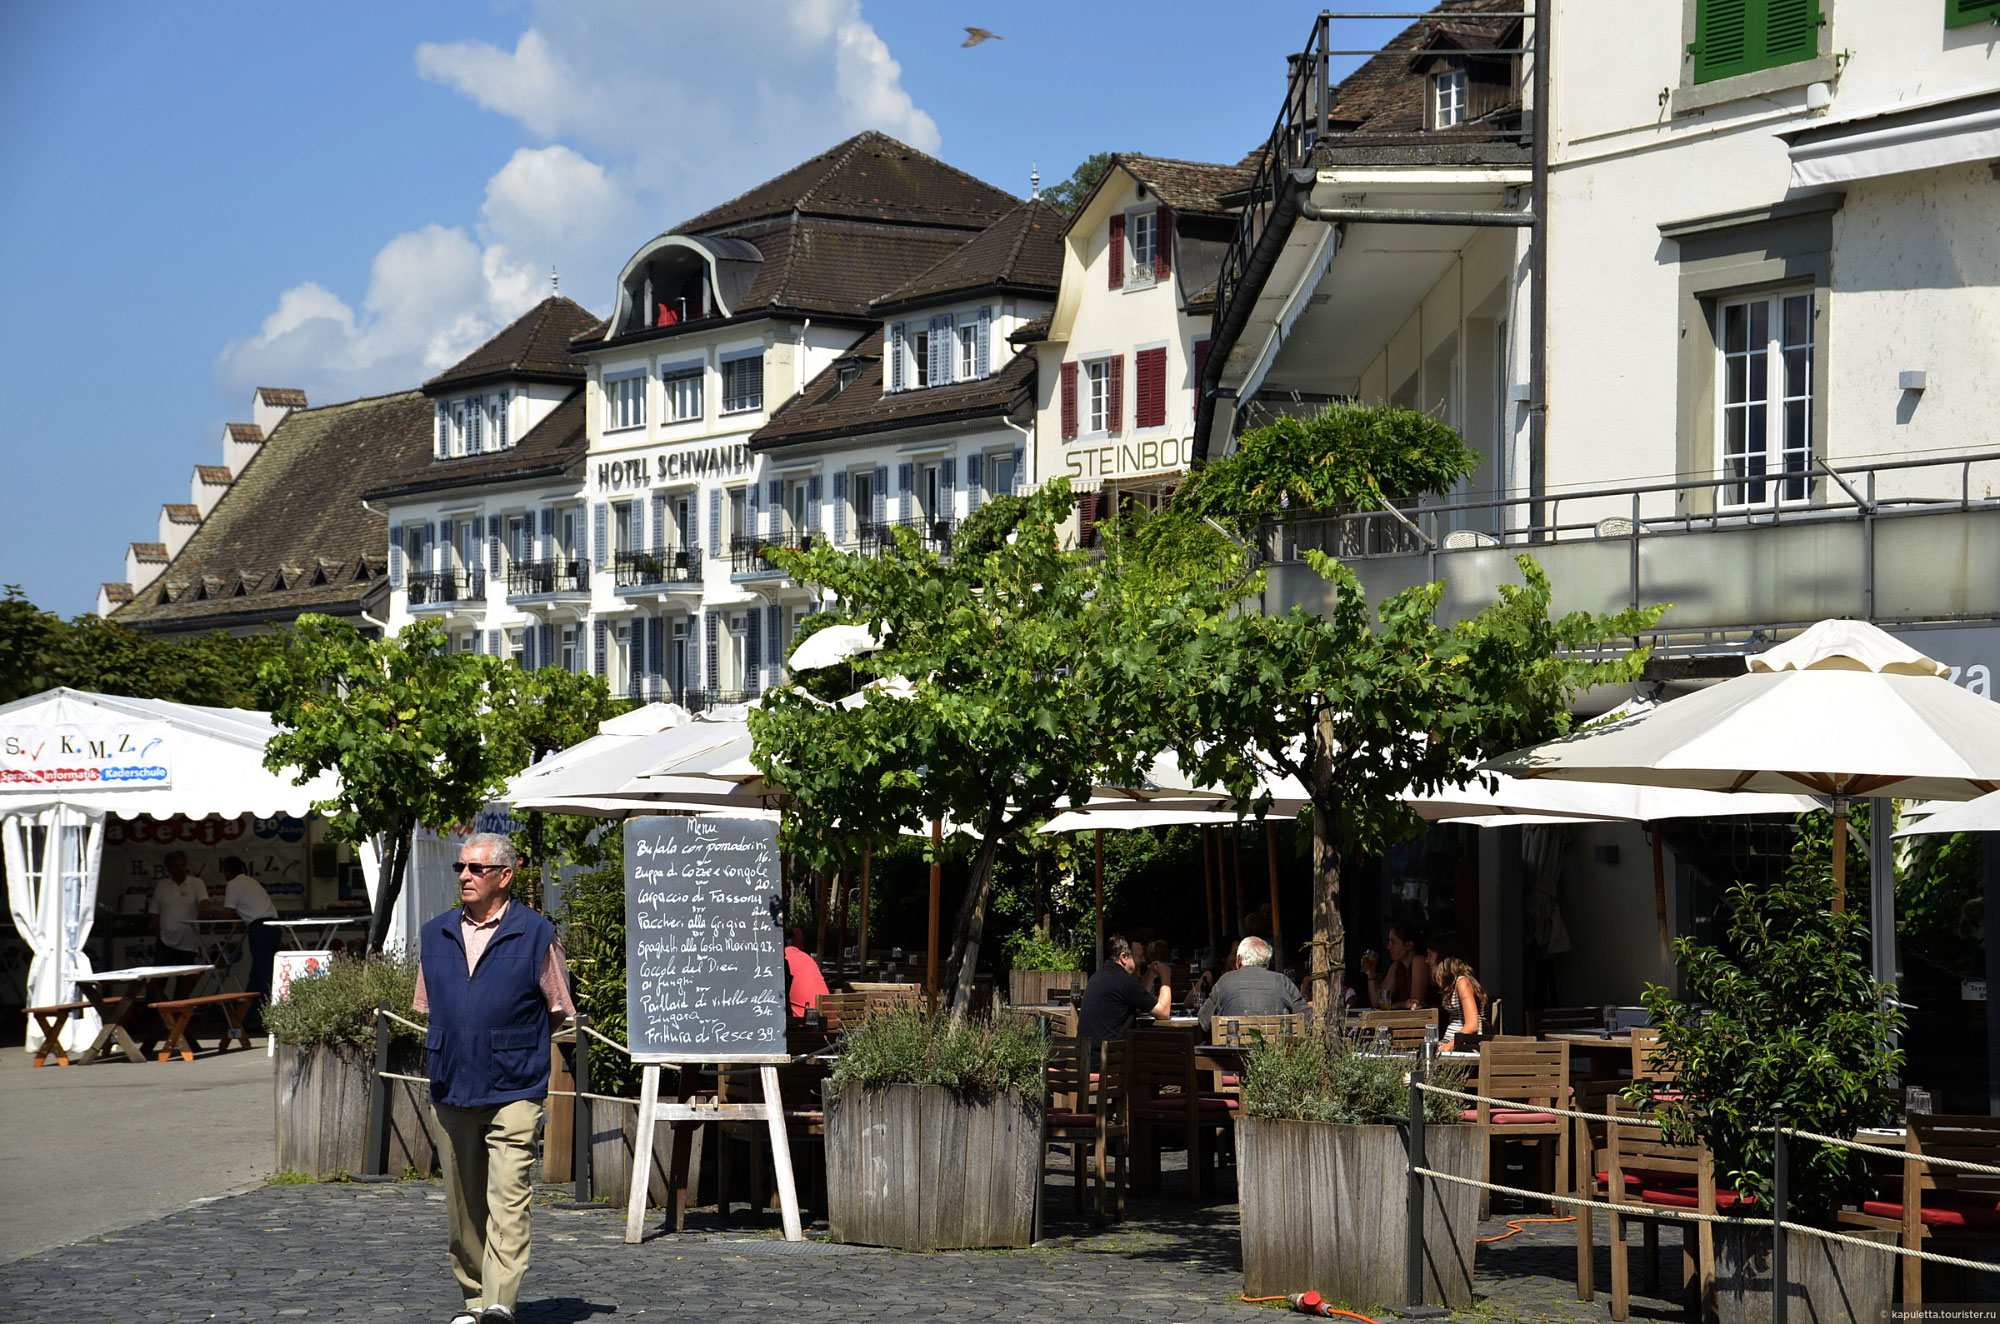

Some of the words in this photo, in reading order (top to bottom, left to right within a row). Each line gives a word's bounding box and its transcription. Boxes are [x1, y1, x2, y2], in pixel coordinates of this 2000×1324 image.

[598, 457, 650, 488] HOTEL
[657, 443, 755, 479] SCHWANEN
[105, 766, 166, 780] Kaderschule
[687, 817, 719, 835] Menu
[636, 835, 678, 861] Bufala
[681, 843, 702, 854] con
[703, 836, 768, 863] pomodorini
[634, 866, 664, 886] Zuppa
[667, 862, 678, 877] di
[713, 867, 720, 877] e
[637, 889, 689, 911] Carpaccio
[691, 886, 705, 903] di
[637, 911, 684, 930] Paccheri
[688, 914, 706, 929] alla
[711, 916, 747, 938] Grigia
[637, 934, 678, 960] Spaghetti
[700, 935, 723, 952] Costa
[725, 938, 759, 953] Marina
[640, 955, 676, 977] Coccole
[682, 955, 704, 974] del
[708, 957, 738, 974] Dieci
[656, 975, 693, 997] funghi
[640, 991, 689, 1013] Paillard
[695, 993, 707, 1008] di
[750, 989, 779, 1005] alla
[645, 1024, 692, 1044] Frittura
[695, 1026, 709, 1043] di
[712, 1022, 753, 1043] Pesce
